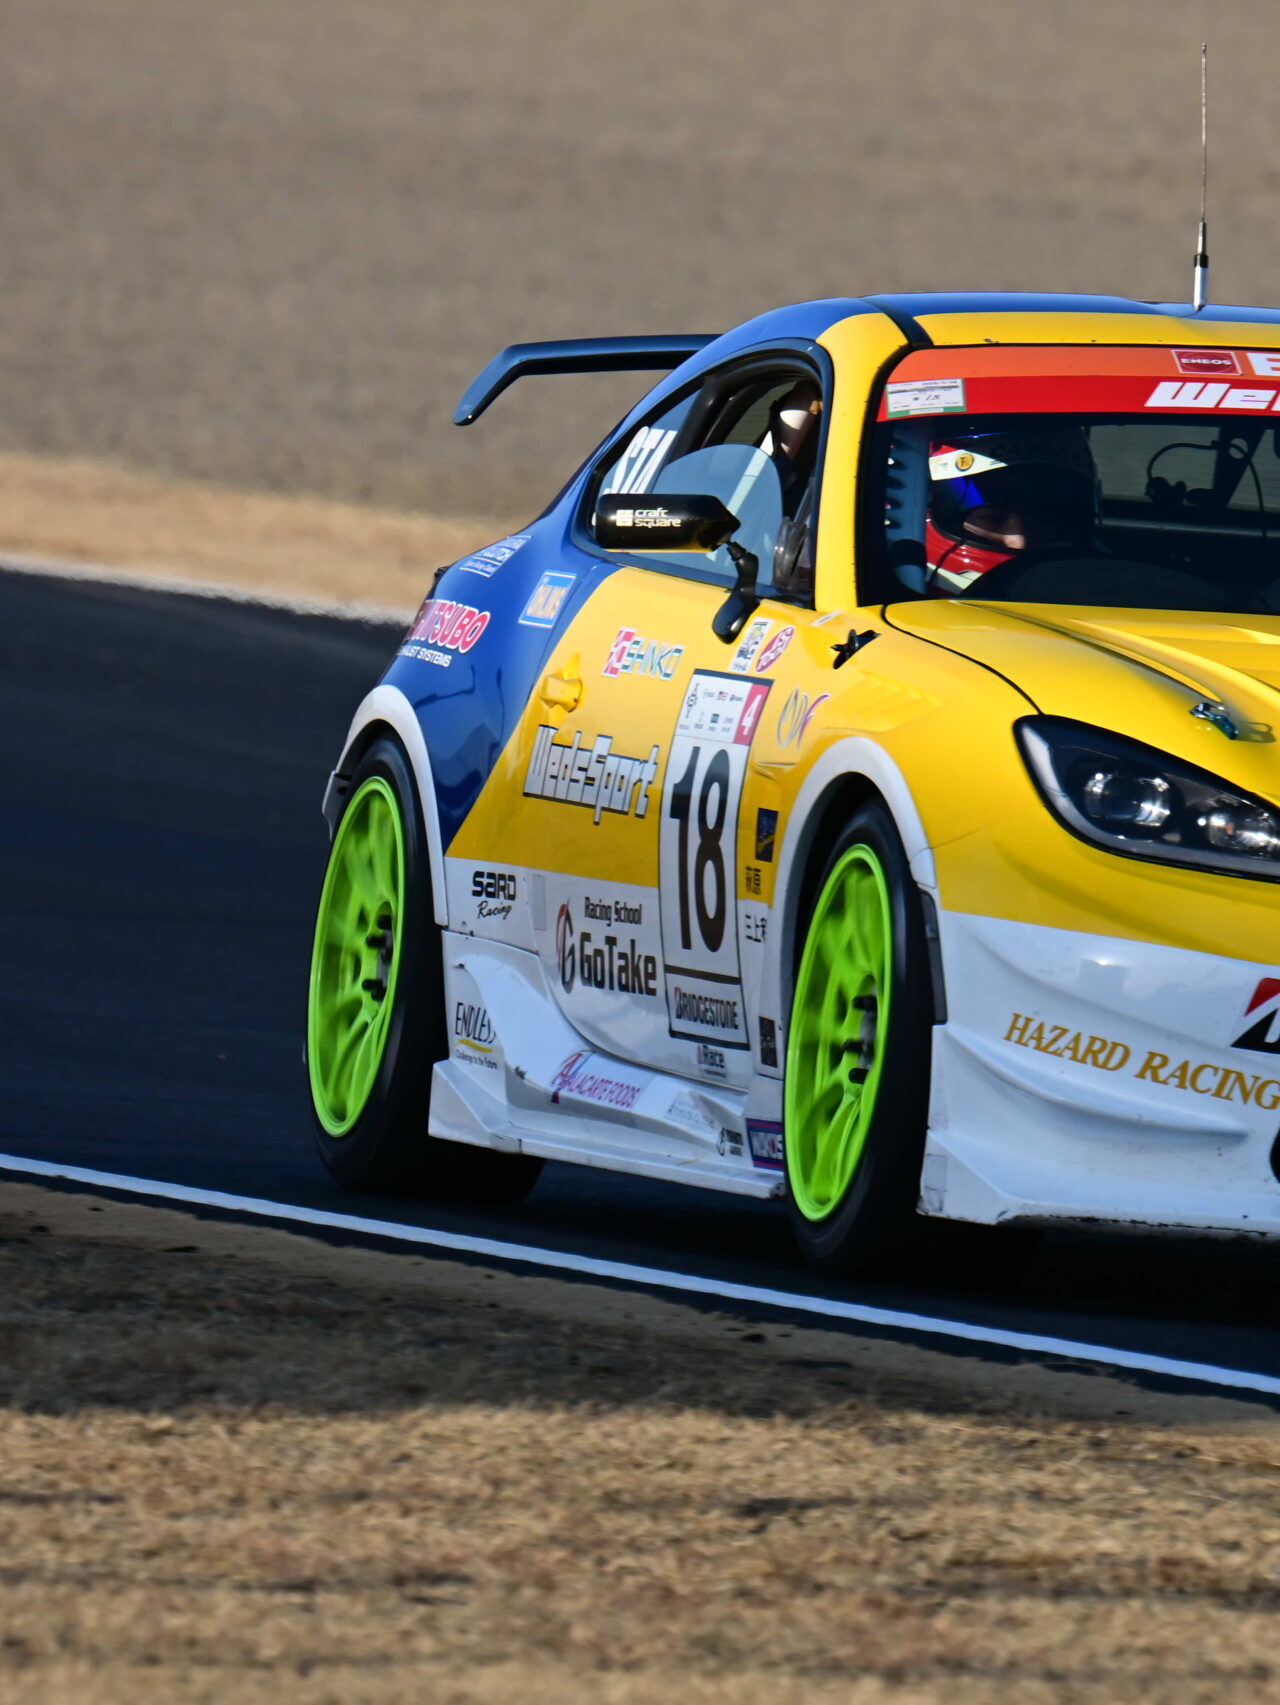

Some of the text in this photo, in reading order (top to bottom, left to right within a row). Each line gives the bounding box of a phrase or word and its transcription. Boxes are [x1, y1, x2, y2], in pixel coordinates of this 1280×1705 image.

[1180, 357, 1232, 366] ENEOS
[634, 518, 682, 529] square
[635, 507, 669, 517] craft
[416, 647, 453, 668] SYSTEMS
[669, 746, 731, 953] 18
[584, 896, 643, 928] Racing School
[579, 931, 658, 996] GoTake
[673, 986, 740, 1030] BRIDGESTONE
[1003, 1012, 1132, 1072] HAZARD
